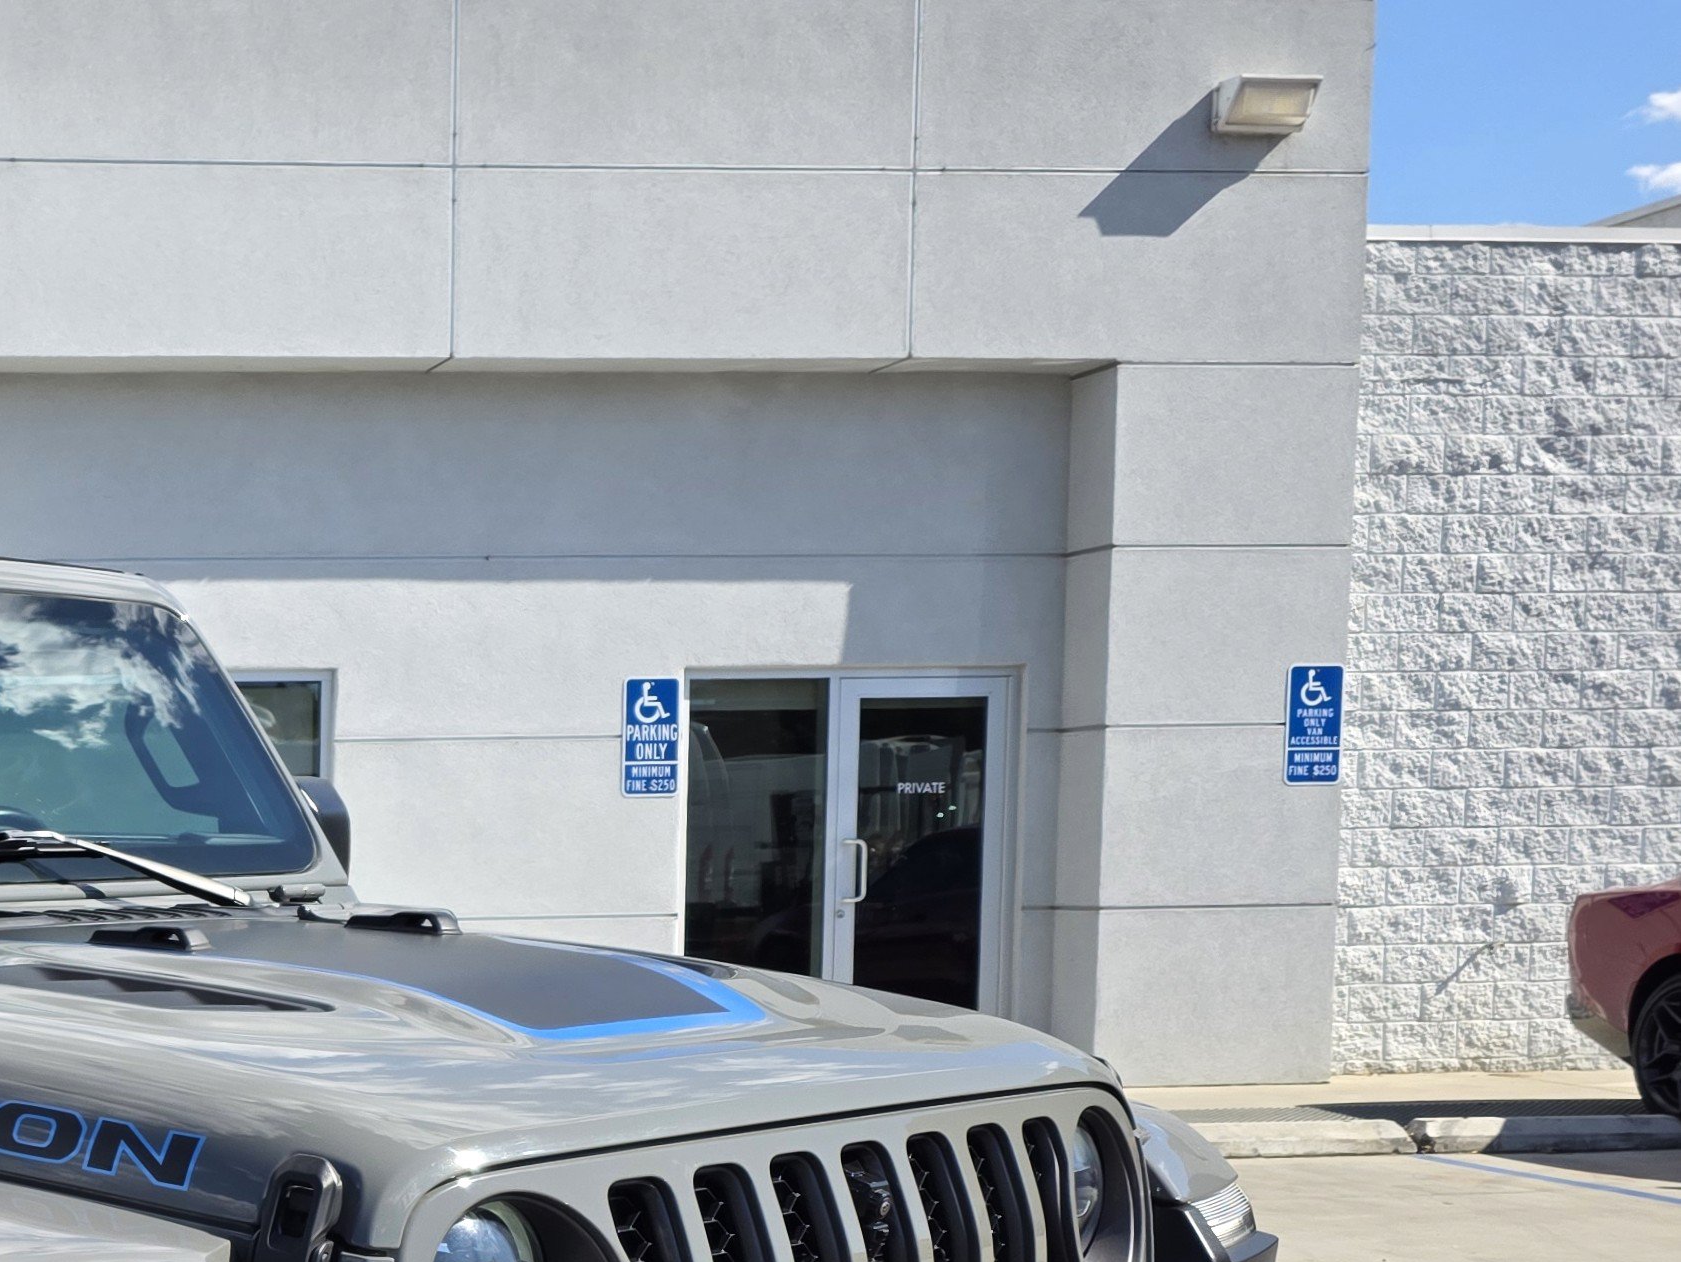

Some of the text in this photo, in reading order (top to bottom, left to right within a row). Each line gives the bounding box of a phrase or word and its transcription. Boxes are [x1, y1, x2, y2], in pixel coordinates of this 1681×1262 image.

[1297, 708, 1334, 718] PARKING
[1303, 718, 1327, 727] ONLY
[626, 724, 678, 742] PARKING
[1306, 727, 1323, 736] VAN
[1290, 736, 1338, 745] ACCESSIBLE
[635, 743, 668, 760] ONLY
[1294, 752, 1333, 763] MINIMUM
[631, 766, 671, 778] MINIMUM
[1288, 765, 1338, 776] FINE $250
[626, 778, 676, 792] FINE $250
[897, 782, 946, 794] PRIVATE
